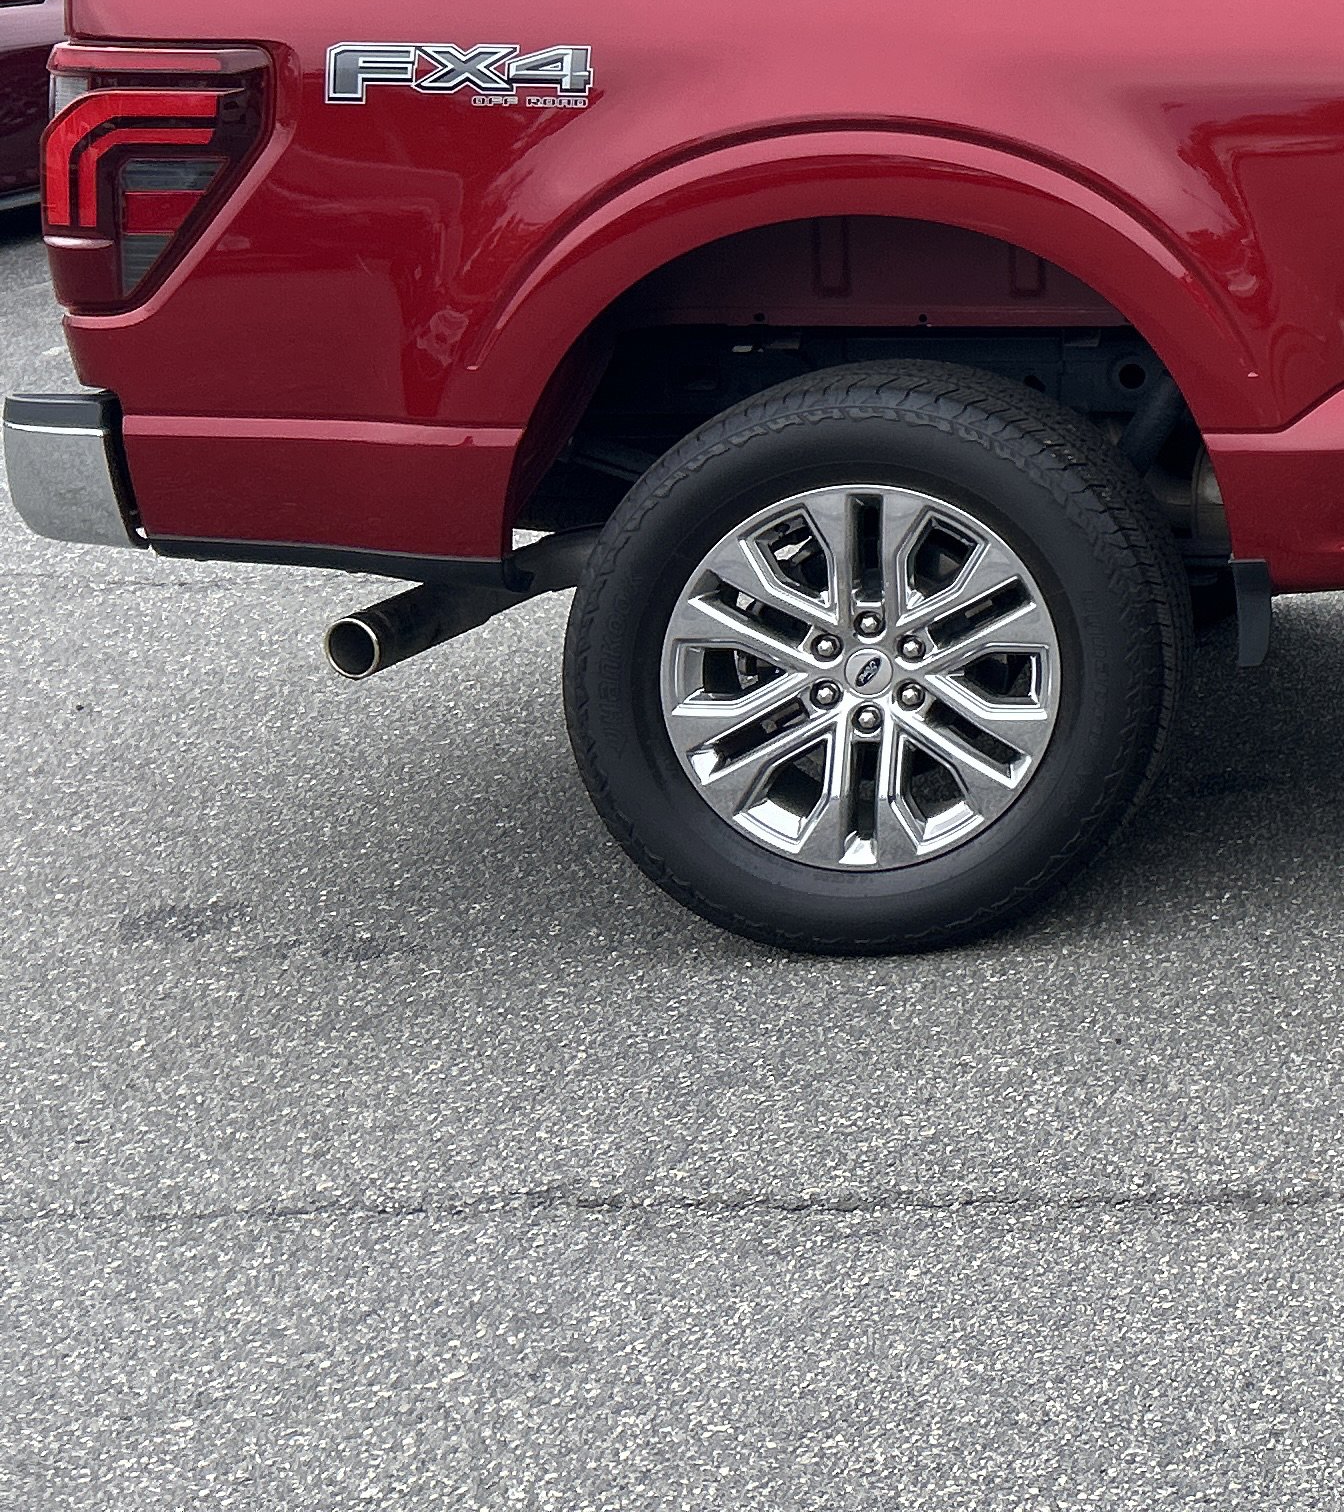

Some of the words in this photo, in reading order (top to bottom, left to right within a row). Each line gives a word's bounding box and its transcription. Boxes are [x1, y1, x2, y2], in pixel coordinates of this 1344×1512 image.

[325, 42, 593, 104] FX4
[471, 95, 519, 107] OFF
[526, 96, 588, 108] ROAD
